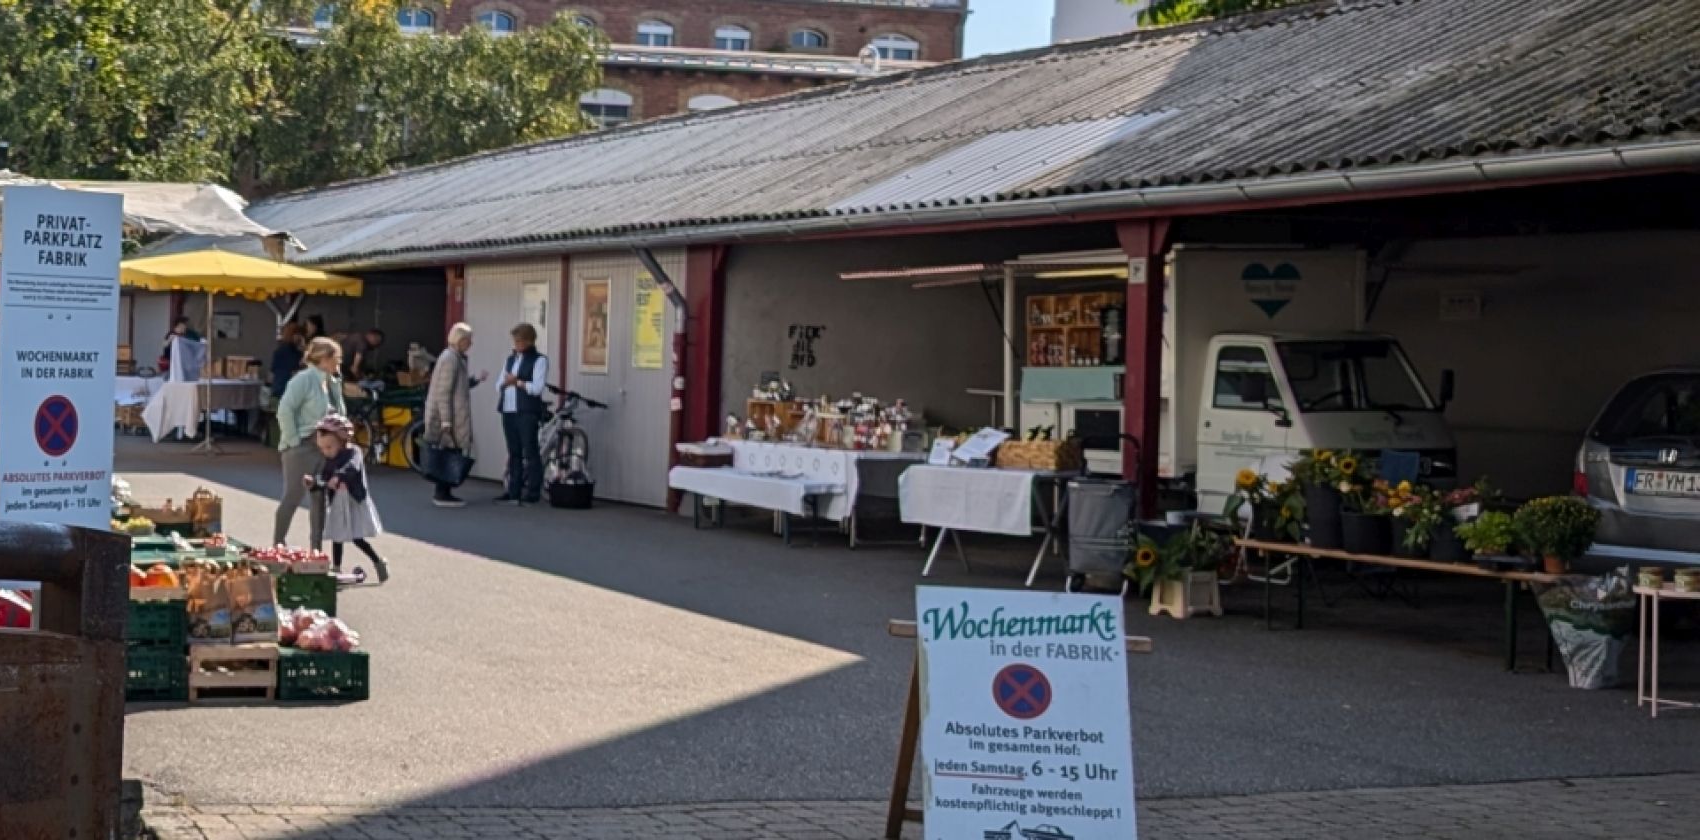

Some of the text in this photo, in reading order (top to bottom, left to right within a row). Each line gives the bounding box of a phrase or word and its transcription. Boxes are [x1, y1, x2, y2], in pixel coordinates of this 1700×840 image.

[36, 213, 91, 231] PRIVAT-
[23, 229, 103, 249] PARKPLATZ
[38, 249, 88, 267] FABRIK
[15, 350, 100, 363] WOCHENMARKT
[21, 367, 94, 379] IN DER FABRIK
[2, 470, 105, 483] ABSOLUTES PARKVERBOT
[1635, 472, 1654, 489] FR
[21, 484, 88, 498] im gesamten Hof
[5, 500, 27, 513] jeden
[29, 499, 62, 511] Samstag
[63, 499, 70, 509] 6
[77, 498, 86, 508] 15
[87, 498, 102, 508] Uhr
[923, 601, 1117, 642] Wochenmarkt
[990, 640, 1115, 662] in der FABRIK
[945, 722, 1105, 744] Absolutes Parkverbot
[988, 741, 1051, 755] gesamten
[1054, 743, 1082, 756] Hof:
[935, 758, 968, 776] jeden
[1031, 760, 1044, 777] 6
[1060, 765, 1080, 783] 15
[1084, 763, 1119, 781] Uhr
[971, 782, 1083, 801] Fahrzeuge werden
[935, 796, 1028, 815] kostenpflichtig
[1030, 801, 1114, 822] abgeschleppt
